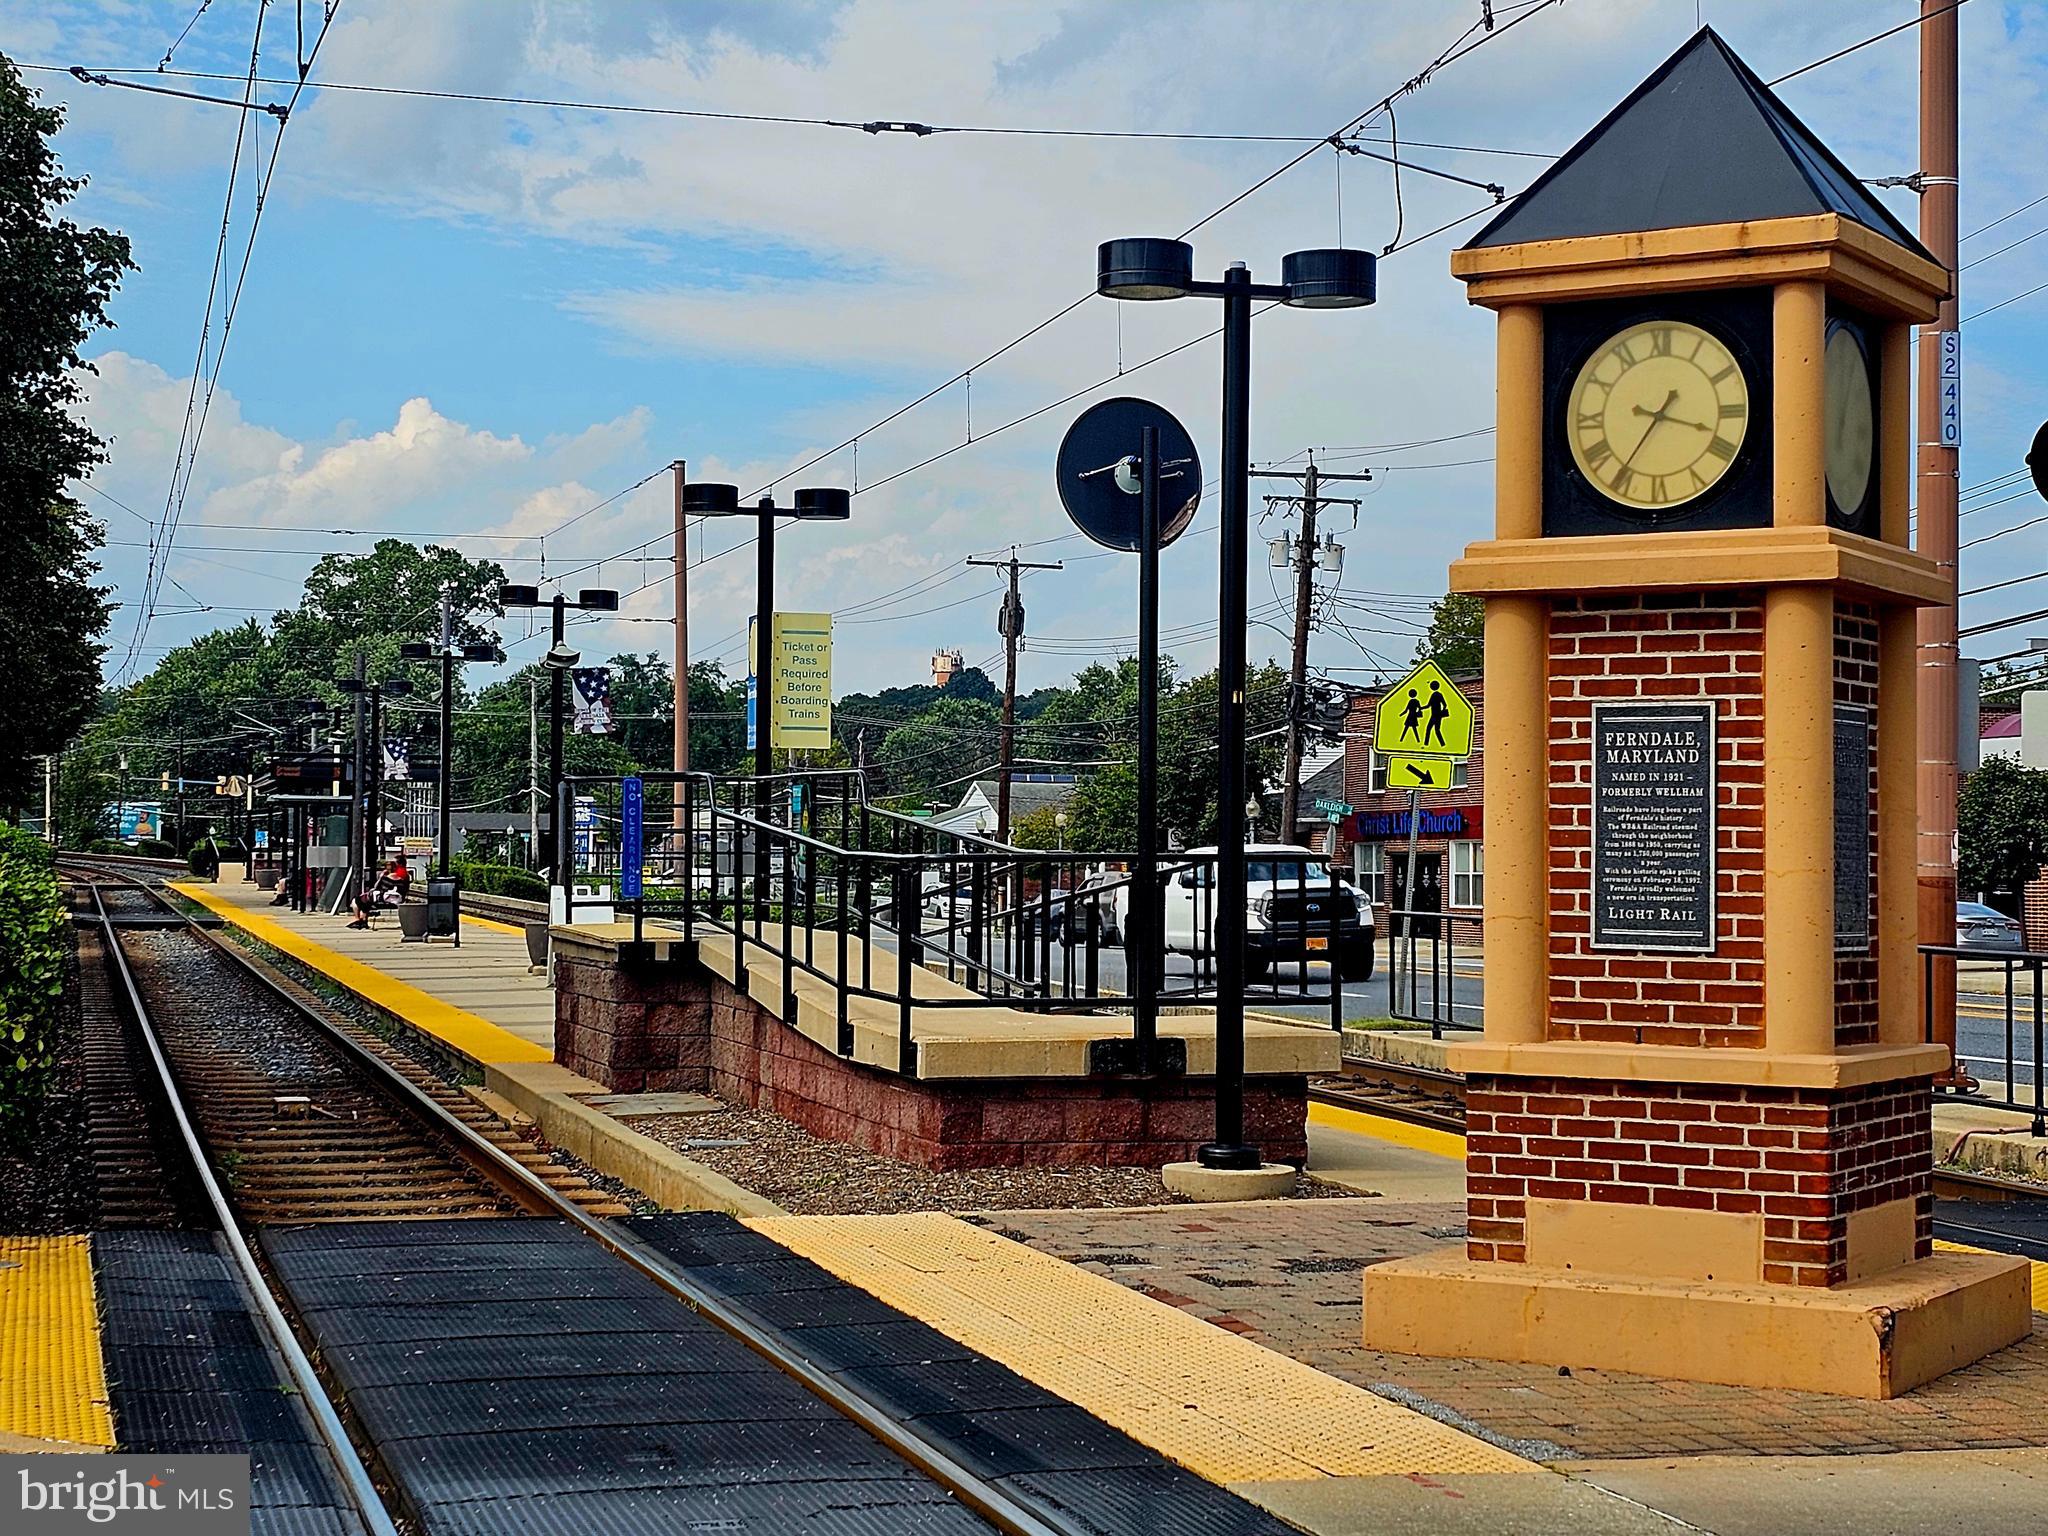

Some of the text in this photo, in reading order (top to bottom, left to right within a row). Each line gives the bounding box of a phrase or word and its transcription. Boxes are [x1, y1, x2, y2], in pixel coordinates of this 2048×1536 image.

[782, 642, 828, 652] Ticket or
[792, 656, 817, 665] Pass
[781, 669, 828, 680] Required
[787, 683, 822, 692] Before
[780, 696, 828, 707] Boarding
[788, 709, 820, 719] Trains
[1604, 732, 1701, 748] FERNDALE,
[1606, 749, 1700, 763] MARYLAND
[1611, 772, 1646, 781] NAMED
[1648, 772, 1660, 781] IN
[1663, 772, 1684, 781] 1921
[1601, 787, 1704, 796] FORMERLY WELLHAM
[1602, 805, 1633, 813] Railroads
[1650, 806, 1665, 814] long
[1357, 812, 1390, 835] Christ
[1393, 811, 1413, 834] Life
[1418, 809, 1461, 833] Church
[628, 783, 636, 893] NO CLEARANCE
[1611, 832, 1637, 840] through
[1650, 832, 1693, 840] neighborhood
[1642, 876, 1672, 884] February
[1608, 906, 1696, 921] LIGHT RAIL
